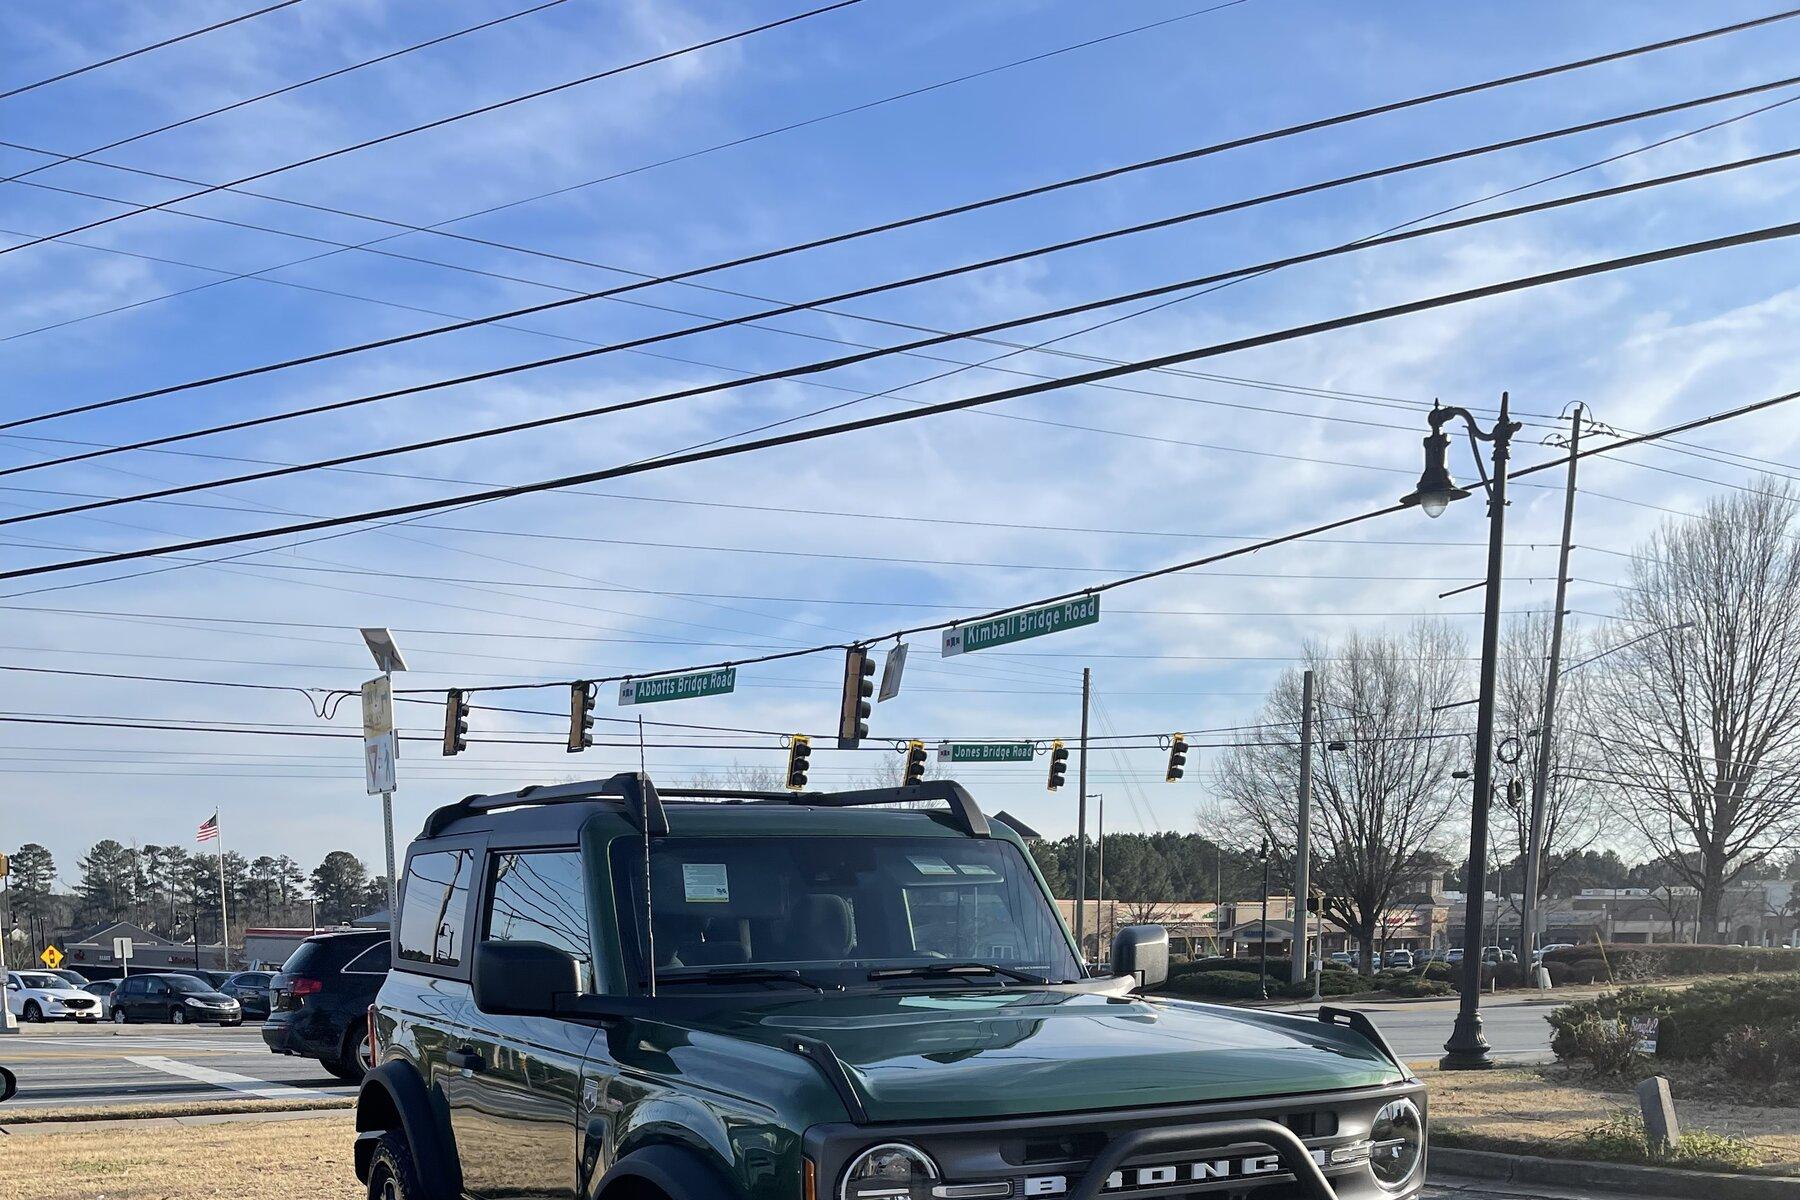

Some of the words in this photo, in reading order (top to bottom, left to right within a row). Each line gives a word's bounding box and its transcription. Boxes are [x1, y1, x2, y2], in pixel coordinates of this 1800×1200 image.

[968, 618, 1015, 644] Kimball
[1019, 609, 1060, 632] Bridge
[1064, 596, 1095, 622] Road
[638, 680, 675, 697] Abbotts
[677, 675, 708, 695] Bridge
[710, 669, 733, 688] Road
[954, 745, 980, 758] Jones
[982, 745, 1010, 760] Bridge
[1012, 745, 1032, 757] Road
